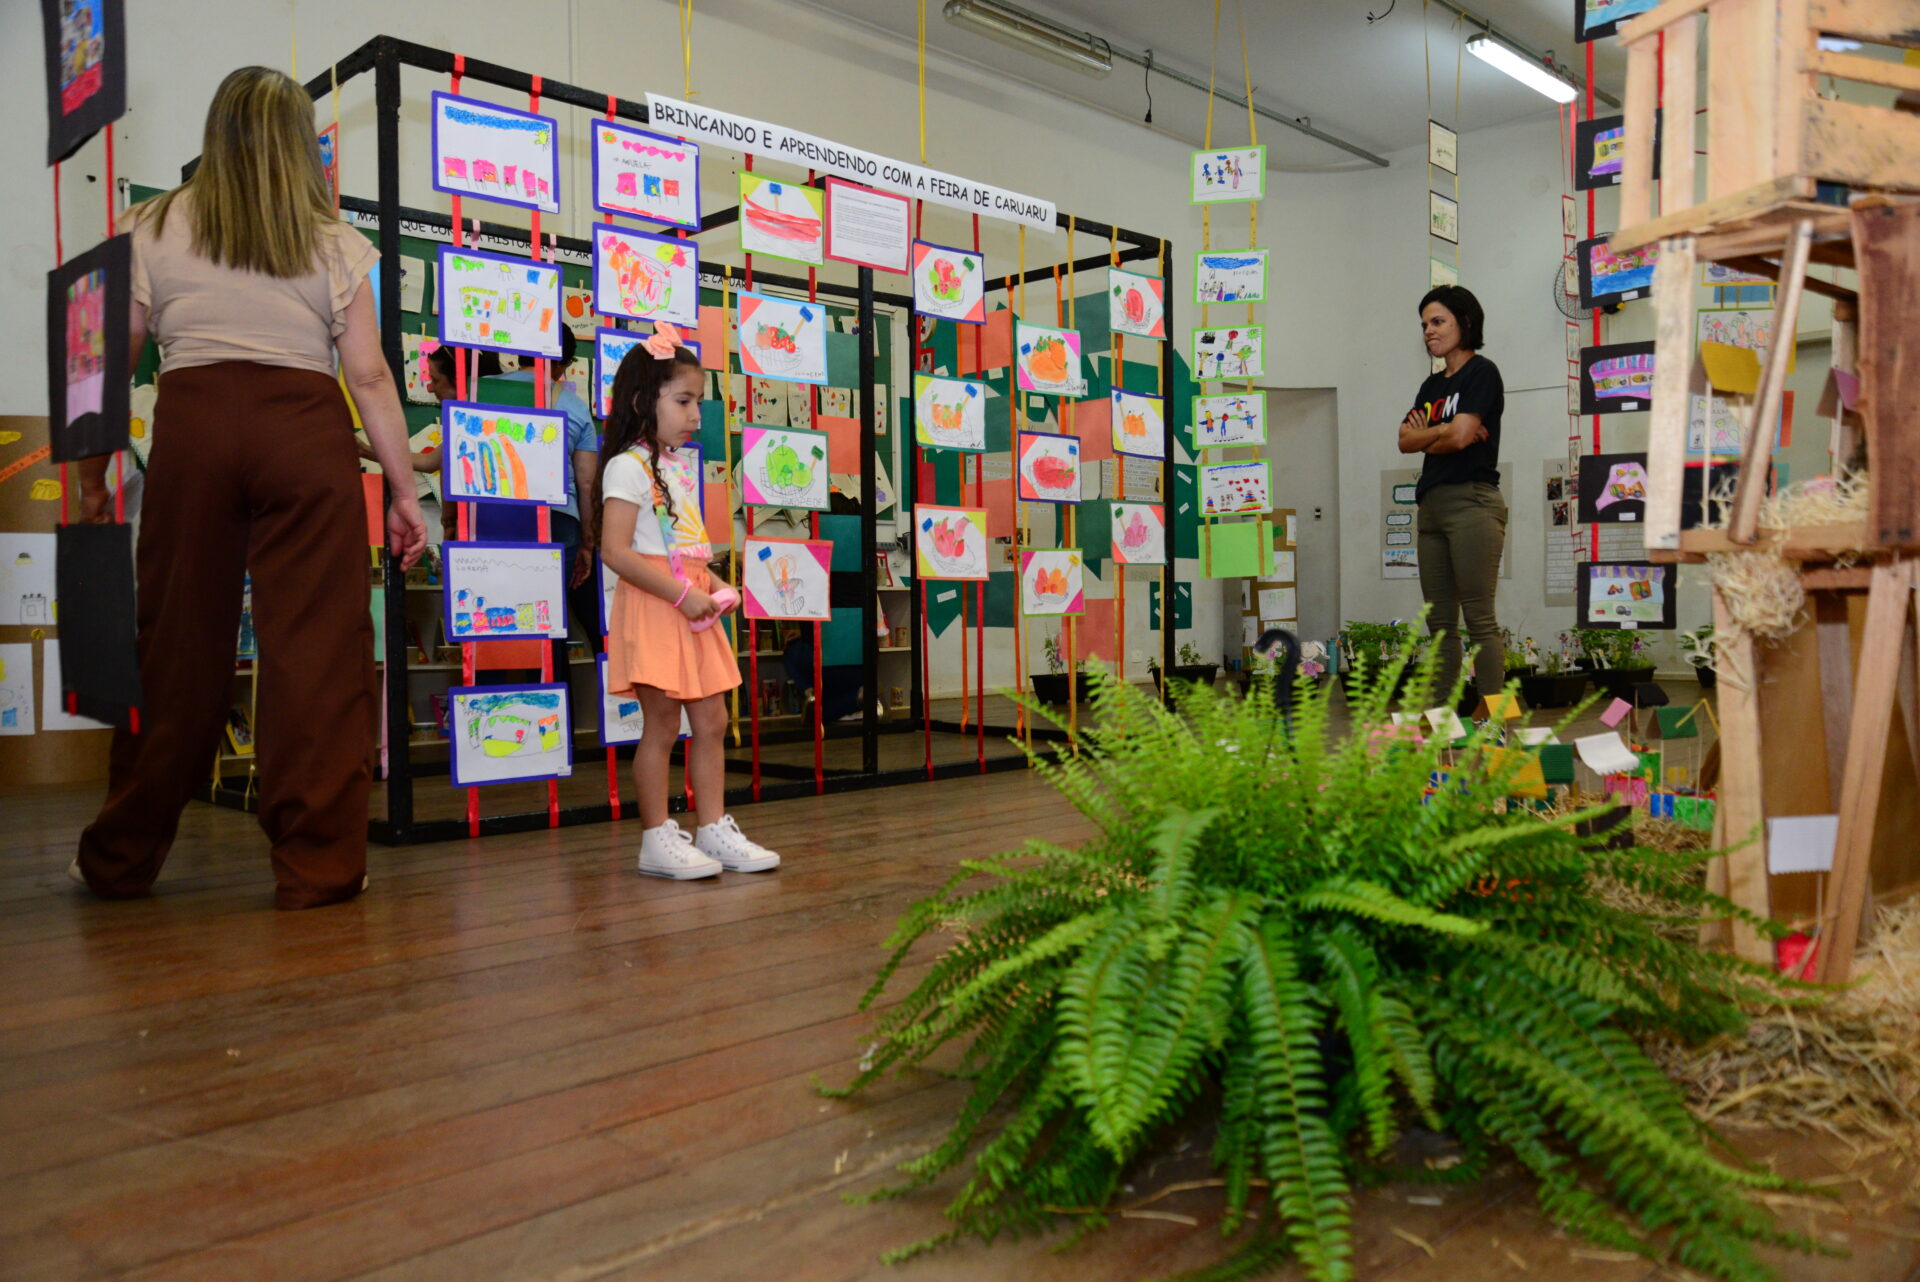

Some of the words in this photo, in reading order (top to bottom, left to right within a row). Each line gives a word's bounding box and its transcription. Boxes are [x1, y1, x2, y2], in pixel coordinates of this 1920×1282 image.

[654, 102, 756, 143] BRINCANDO
[763, 130, 772, 148] E
[780, 136, 877, 176] APRENDENDO
[883, 165, 912, 188] COM
[917, 176, 925, 190] A
[931, 177, 968, 201] FEIRA
[974, 188, 989, 207] DE
[995, 195, 1047, 222] CARUARU
[401, 219, 426, 233] QUE
